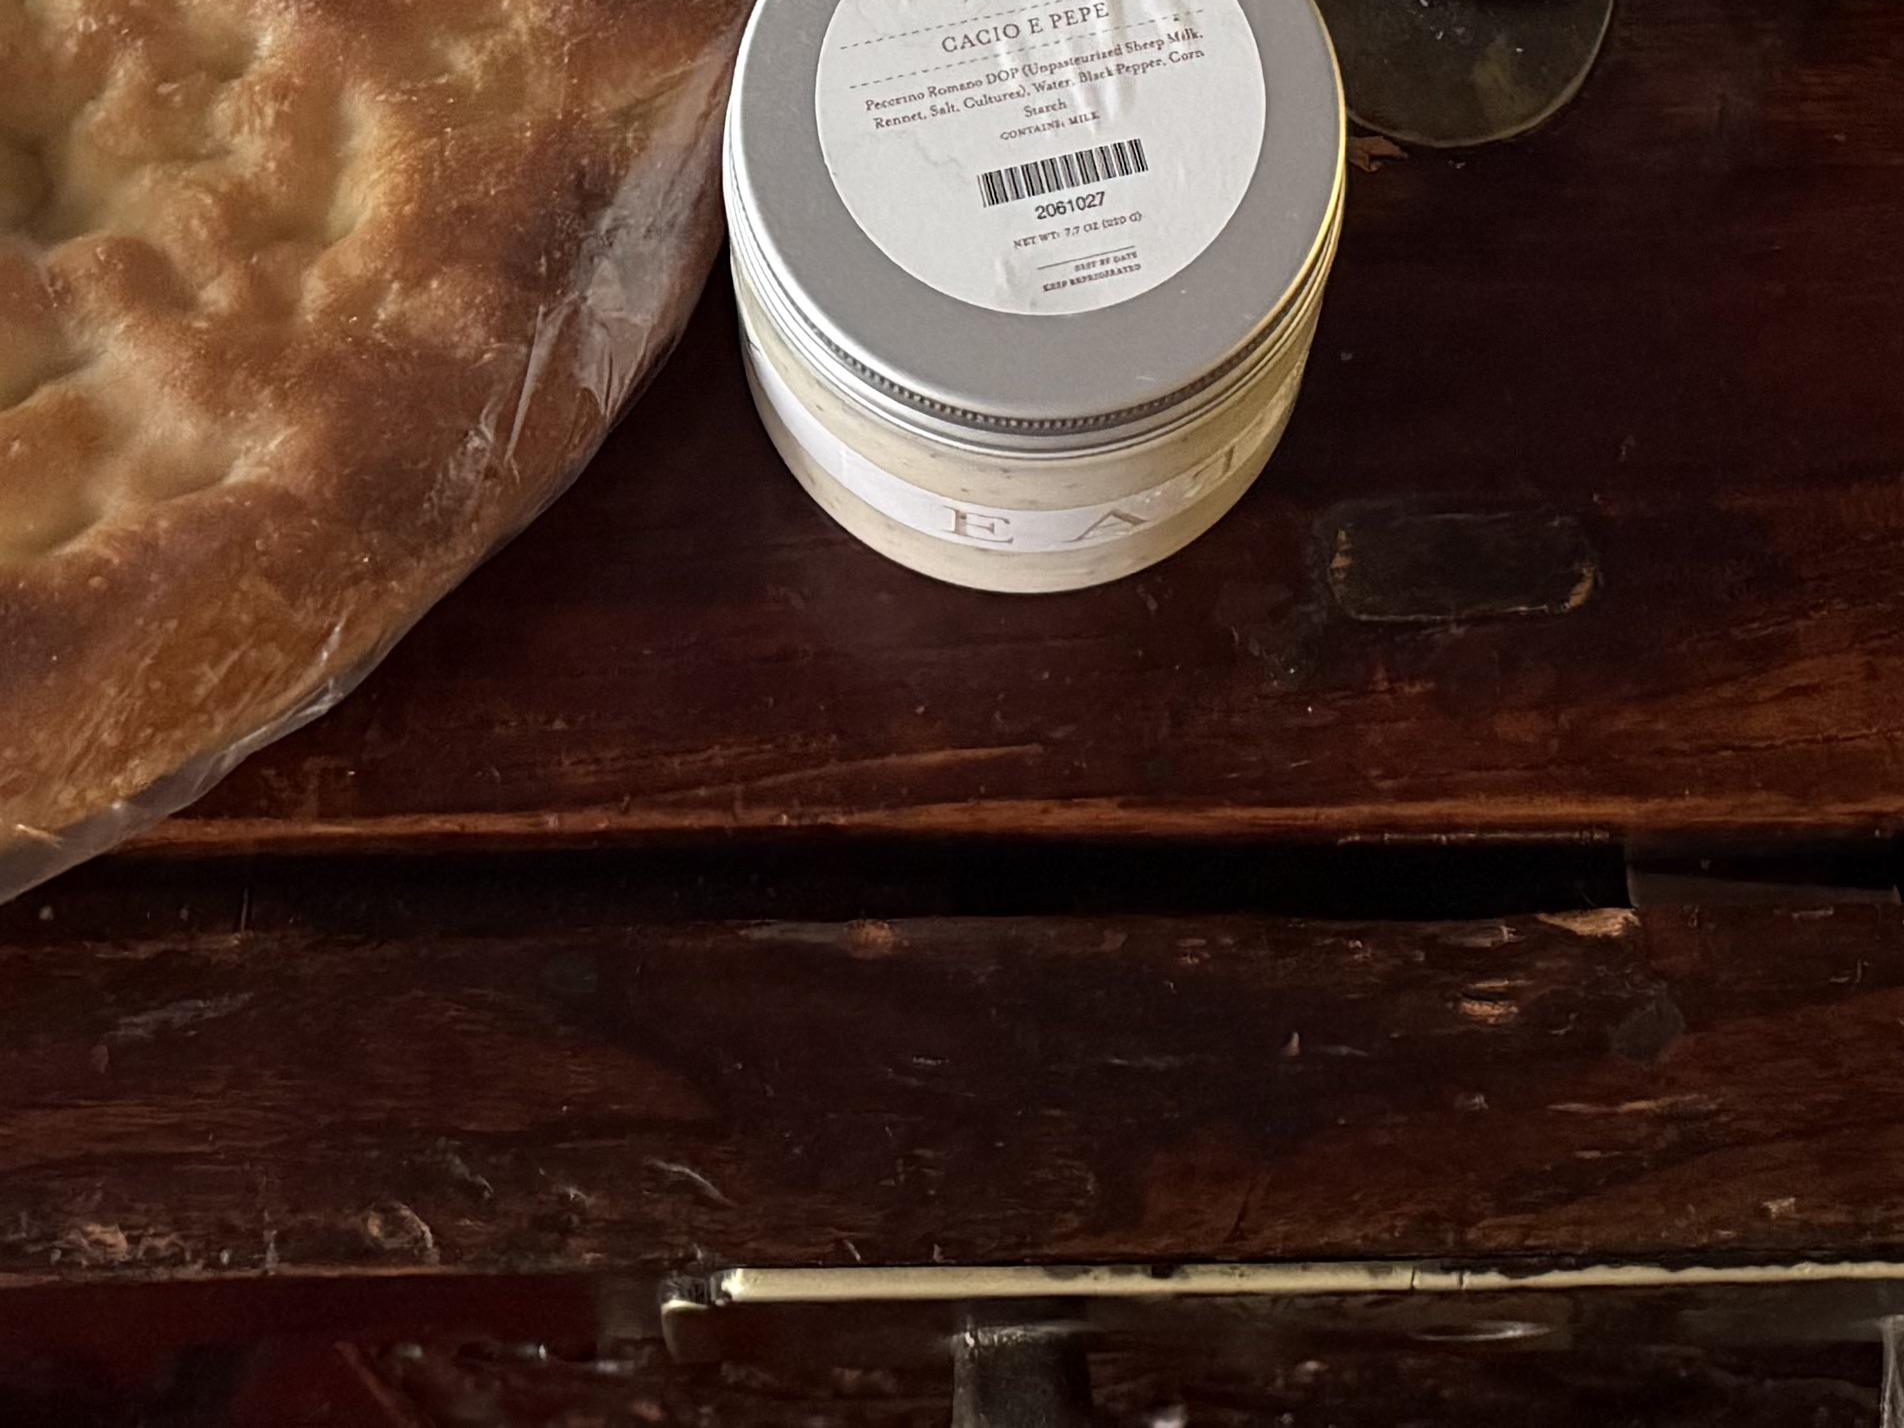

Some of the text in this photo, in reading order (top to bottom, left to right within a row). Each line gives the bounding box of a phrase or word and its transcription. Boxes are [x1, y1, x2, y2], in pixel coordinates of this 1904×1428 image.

[941, 2, 1110, 52] CACIO E PEPE
[1079, 67, 1114, 84] Black
[1169, 48, 1205, 64] Corn
[1024, 98, 1068, 118] Starch
[1035, 191, 1106, 220] 2061027
